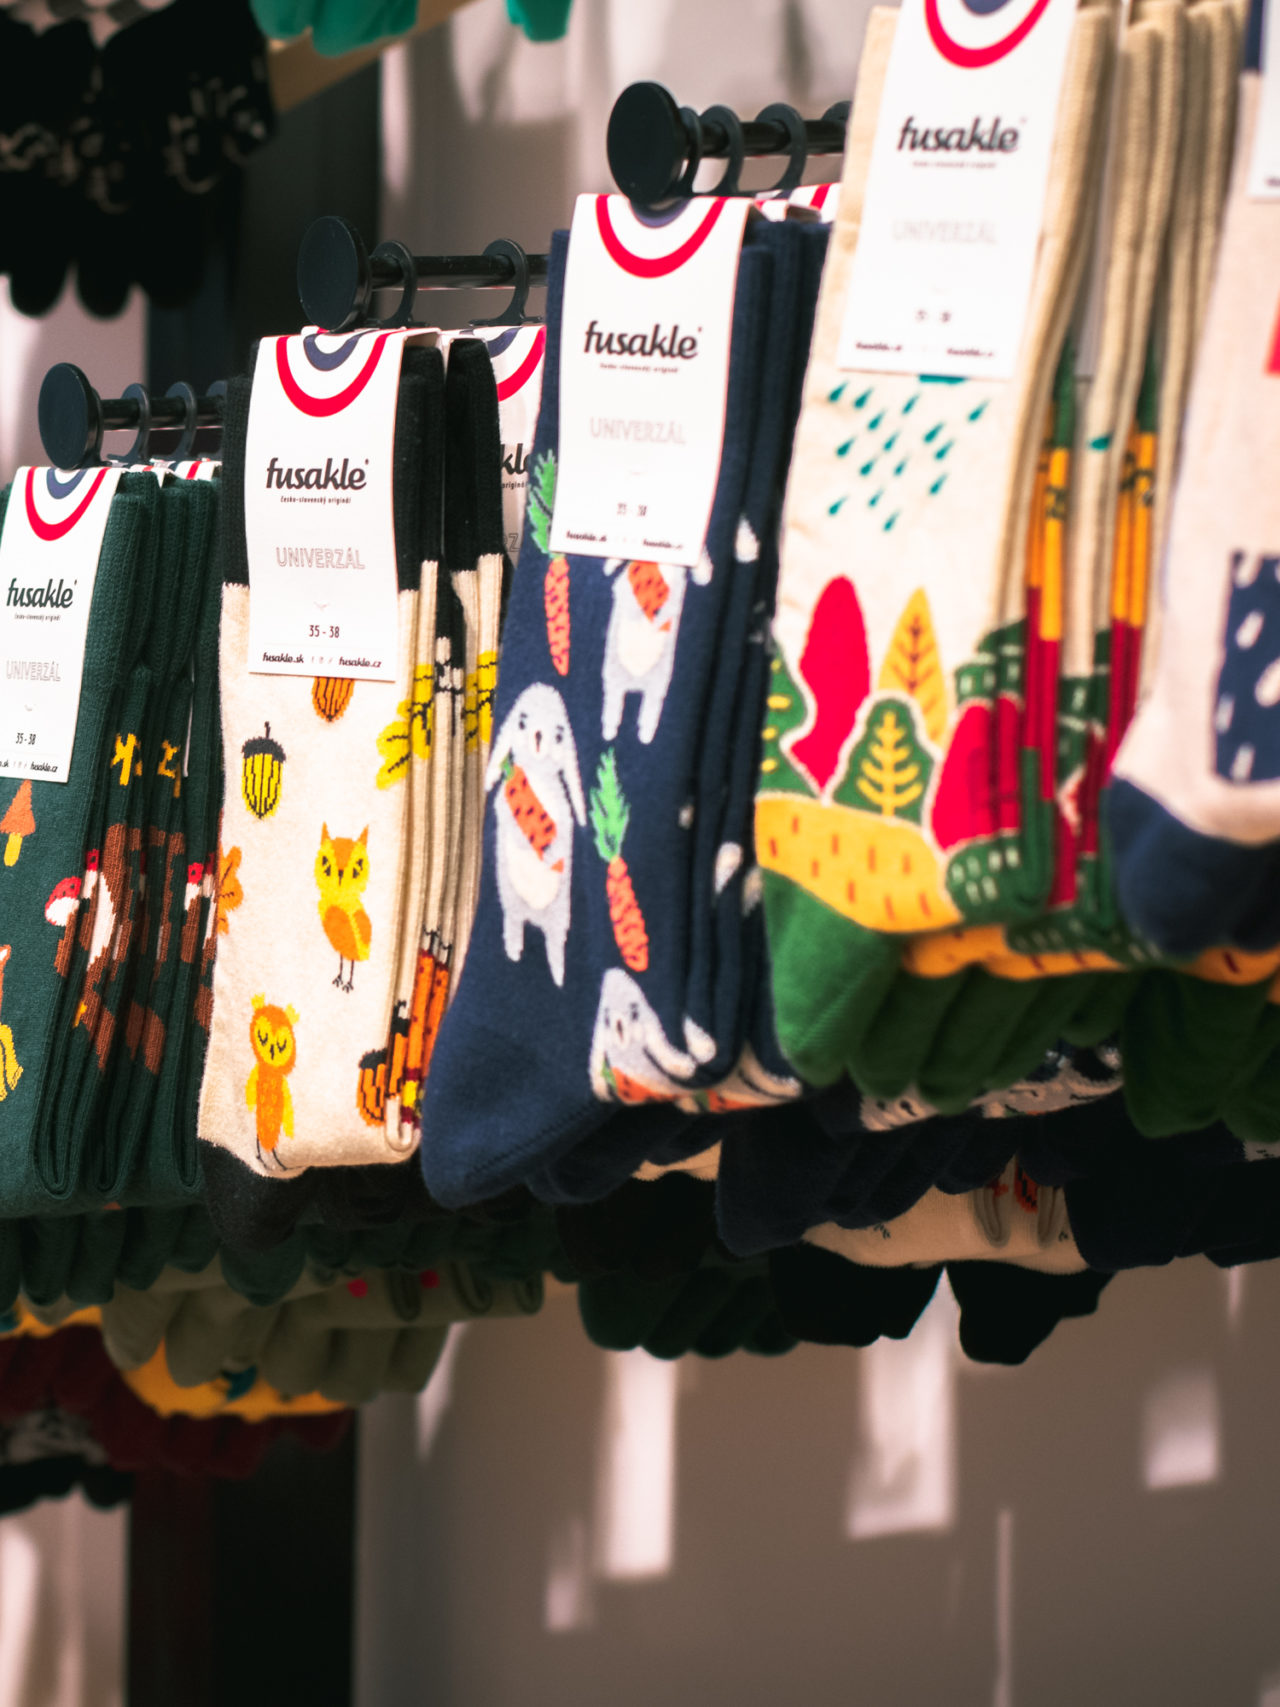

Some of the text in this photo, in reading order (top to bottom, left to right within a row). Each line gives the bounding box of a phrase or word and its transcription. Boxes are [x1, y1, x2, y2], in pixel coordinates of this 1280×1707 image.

[897, 115, 1020, 153] fusakle
[584, 319, 699, 360] fusakle
[266, 457, 367, 490] fusakle
[276, 546, 365, 570] UNIVERZÁL
[6, 577, 74, 609] fusakle
[309, 624, 320, 638] 35
[329, 625, 340, 639] 38
[6, 660, 61, 682] UNIVERZÁL
